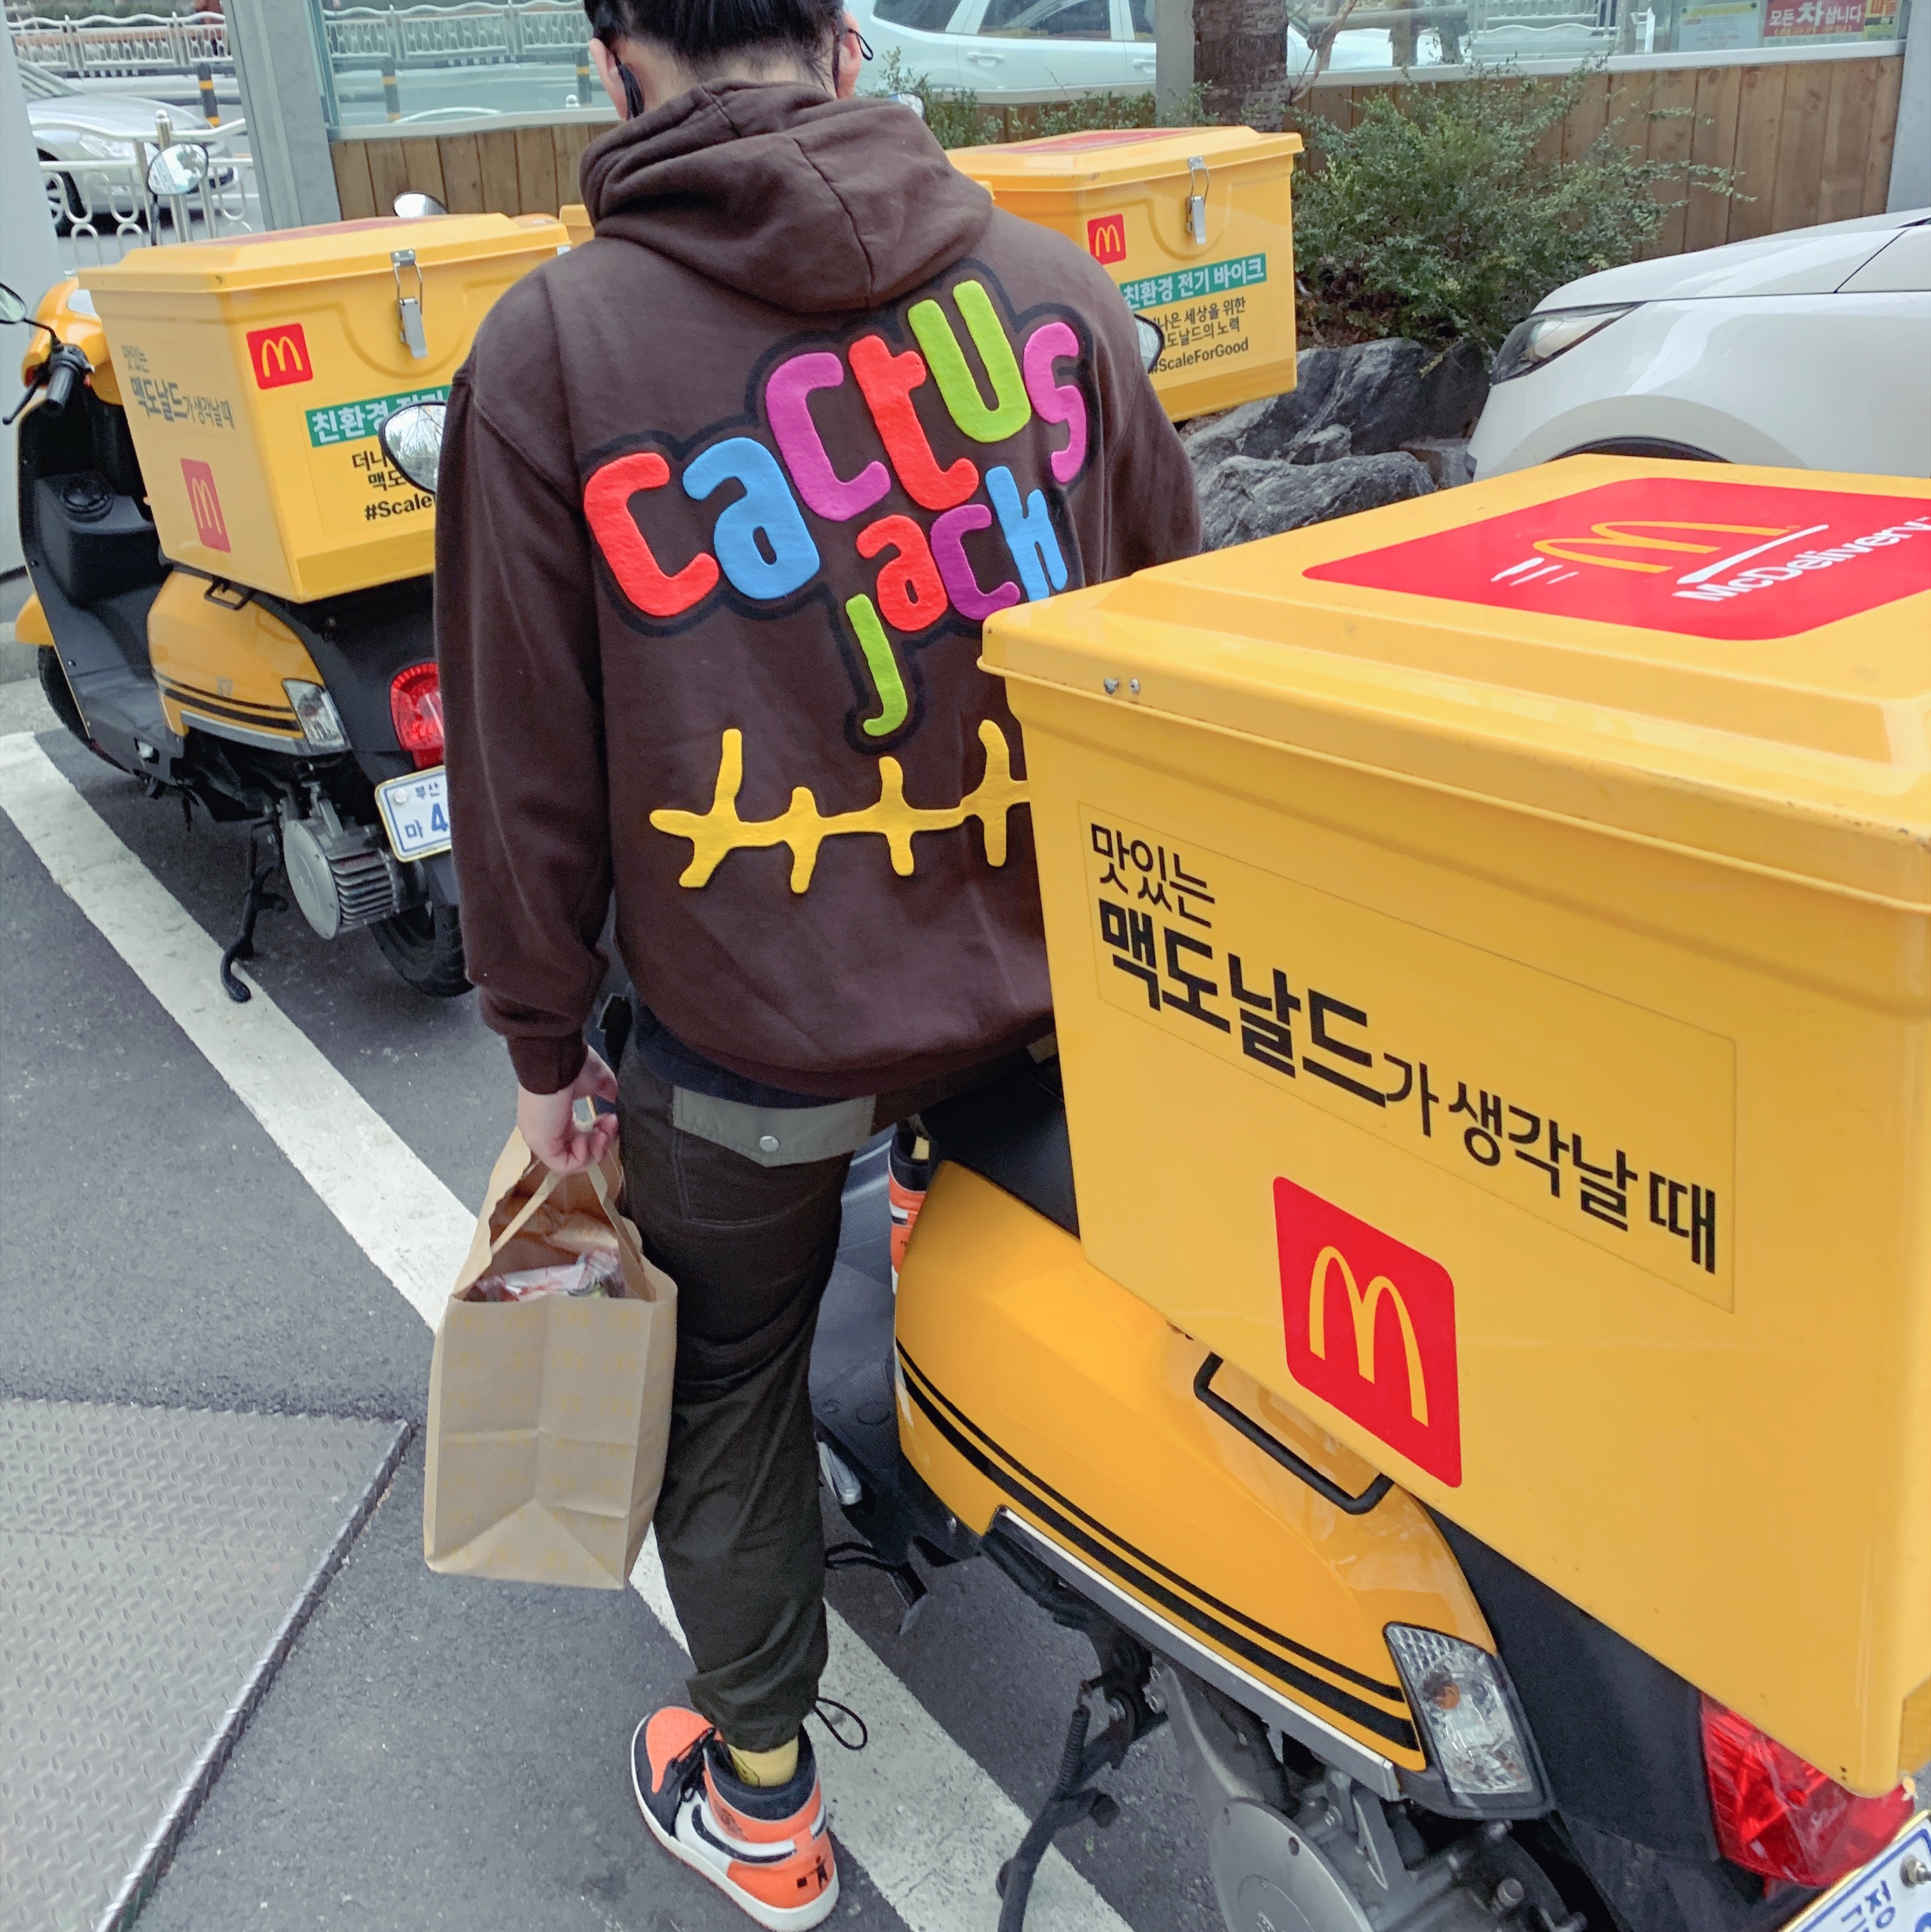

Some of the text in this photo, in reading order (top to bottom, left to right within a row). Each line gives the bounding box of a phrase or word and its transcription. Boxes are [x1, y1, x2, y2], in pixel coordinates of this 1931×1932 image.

[1769, 9, 1794, 26] 모든
[1796, 1, 1824, 26] 차
[1825, 4, 1863, 25] 삽니다
[1124, 257, 1264, 309] 친환경 전기 바이크
[1153, 296, 1245, 331] 나은 세상을 위한
[1163, 316, 1239, 351] 도날드의 노력
[312, 400, 389, 444] 친환경
[416, 782, 440, 799] 부산
[404, 802, 449, 839] 마 4
[1091, 823, 1215, 929] 맛있는
[1098, 898, 1716, 1275] 맥도날드가 생각날 때
